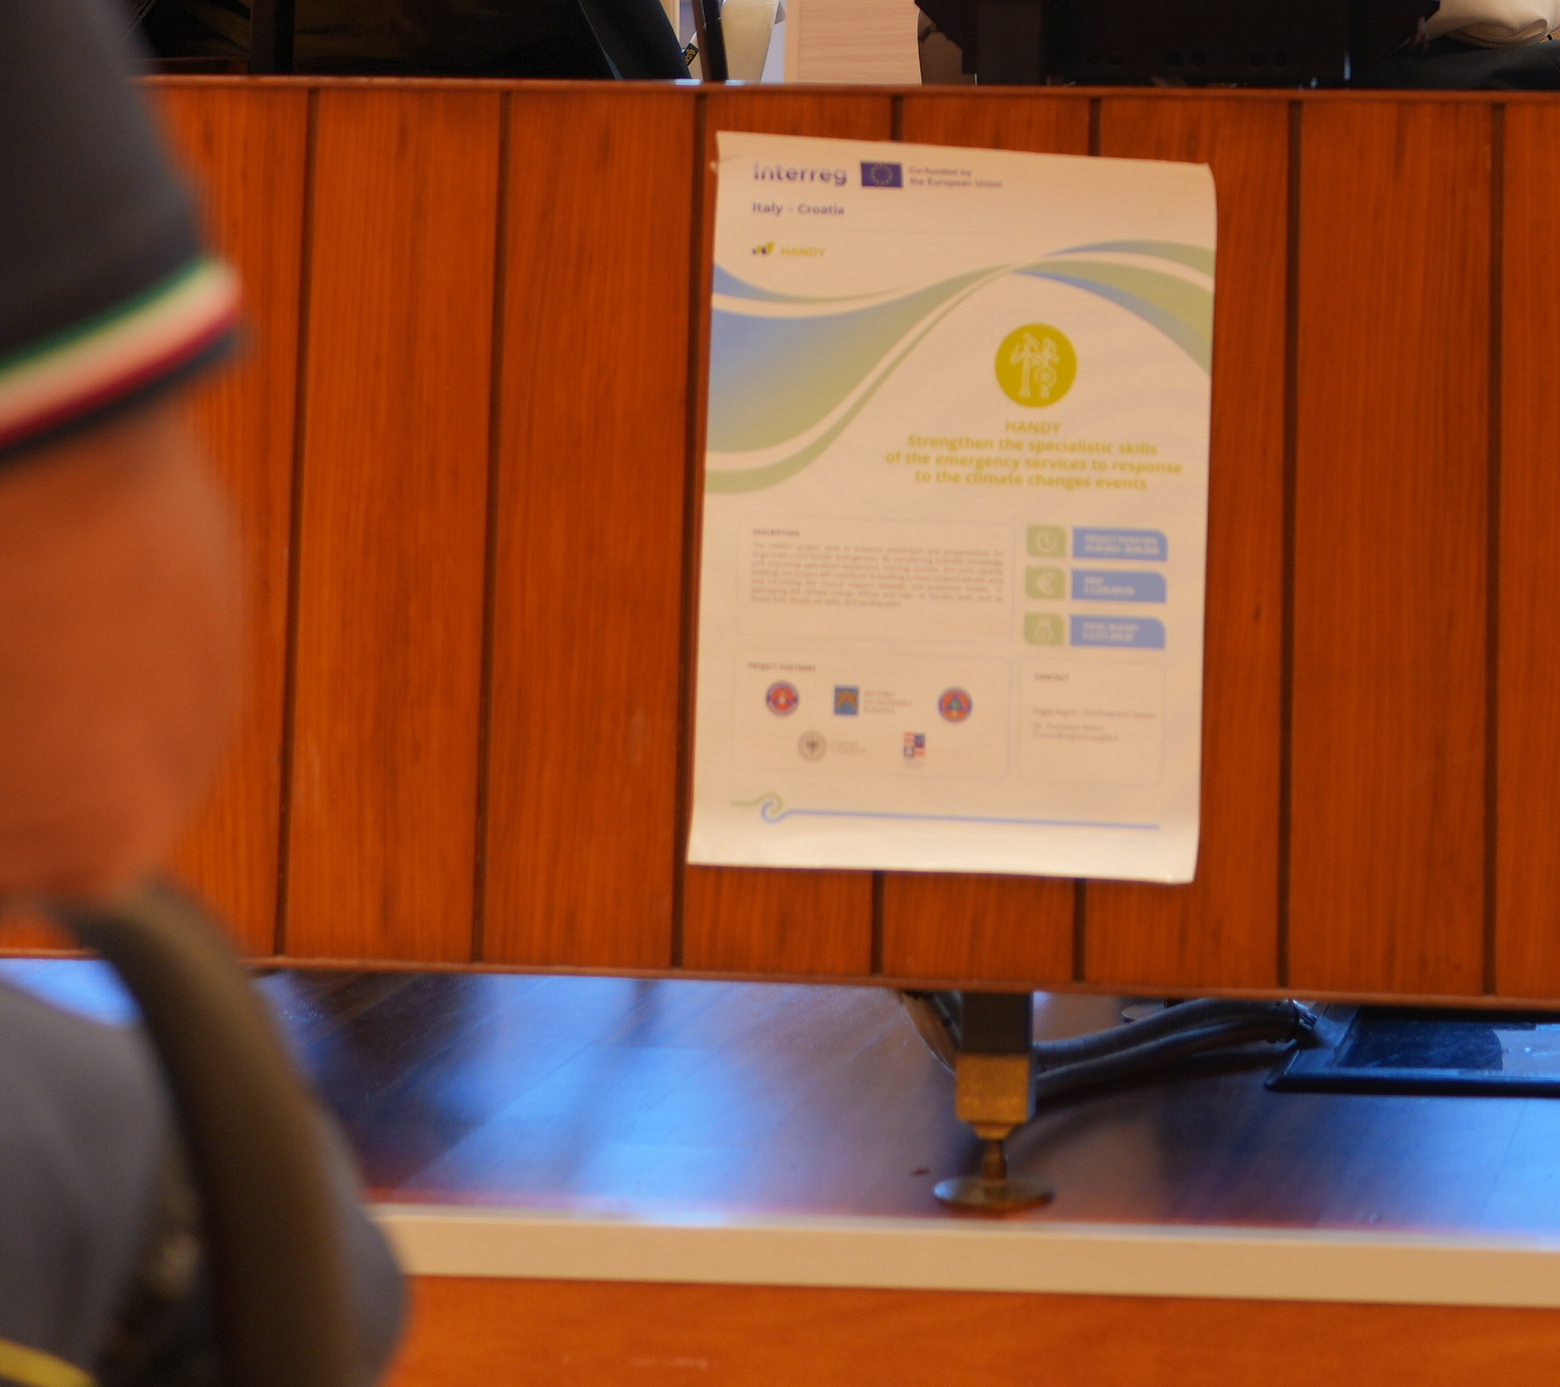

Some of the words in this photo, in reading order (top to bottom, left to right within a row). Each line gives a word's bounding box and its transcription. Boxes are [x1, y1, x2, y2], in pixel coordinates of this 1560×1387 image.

[1005, 420, 1061, 434] HANDY
[908, 433, 994, 453] Strengthen
[998, 437, 1025, 451] the
[1029, 437, 1114, 456] specialistic
[1118, 440, 1158, 456] skills
[886, 450, 906, 464] of
[911, 451, 938, 465] the
[942, 453, 1021, 473] emergency
[1025, 456, 1087, 471] services
[1091, 457, 1106, 471] to
[1111, 461, 1183, 477] response
[915, 468, 930, 482] to
[934, 468, 962, 483] the
[966, 469, 1023, 486] climate
[1027, 473, 1091, 492] changes
[1096, 475, 1147, 491] events
